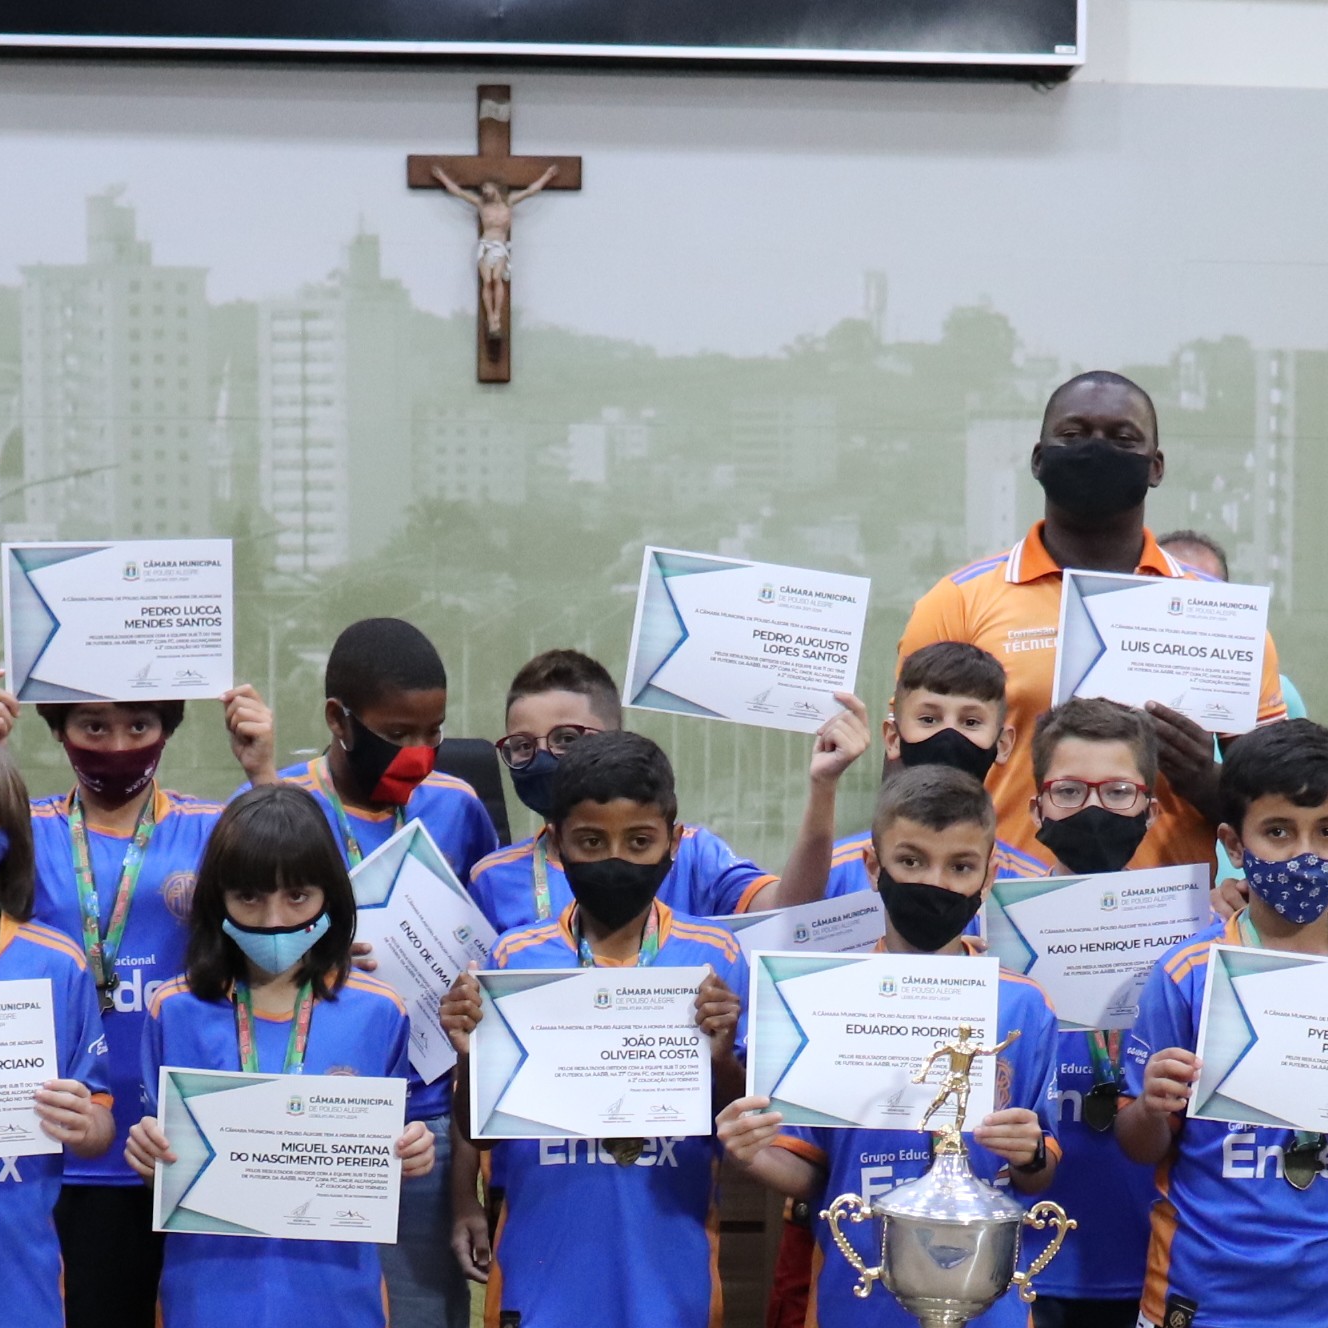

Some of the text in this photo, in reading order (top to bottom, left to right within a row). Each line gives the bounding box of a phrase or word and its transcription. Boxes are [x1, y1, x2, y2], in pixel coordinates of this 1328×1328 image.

[814, 591, 857, 603] MUNICIPAL
[141, 606, 221, 616] PEDRO LUCCA
[124, 618, 222, 629] MENDES SANTOS
[753, 630, 849, 651] PEDRO AUGUSTO
[1003, 638, 1056, 654] TÉCNIC
[763, 644, 847, 664] LOPES SANTOS
[1121, 640, 1253, 662] LUIS CARLOS ALVES
[1121, 883, 1199, 897] CÂMARA MUNICIPAL
[1047, 933, 1199, 955] KAIO HENRIQUE FLAUZIN
[114, 954, 156, 966] acional
[399, 920, 452, 988] ENZO DE LIMA
[901, 975, 987, 986] CÂMARA MUNICIPAL
[615, 986, 699, 995] CÂMARA MUNICIPAL
[846, 1024, 984, 1039] EDUARDO RODRIGES
[622, 1034, 699, 1047] JOÃO PAULO
[601, 1049, 698, 1061] OLIVEIRA COSTA
[309, 1094, 394, 1106] CÂMARA MUNICIPAL
[281, 1142, 390, 1155] MIGUEL SANTANA
[230, 1152, 389, 1168] DO NASCIMENTO PEREIRA
[860, 1152, 896, 1165] Grupo
